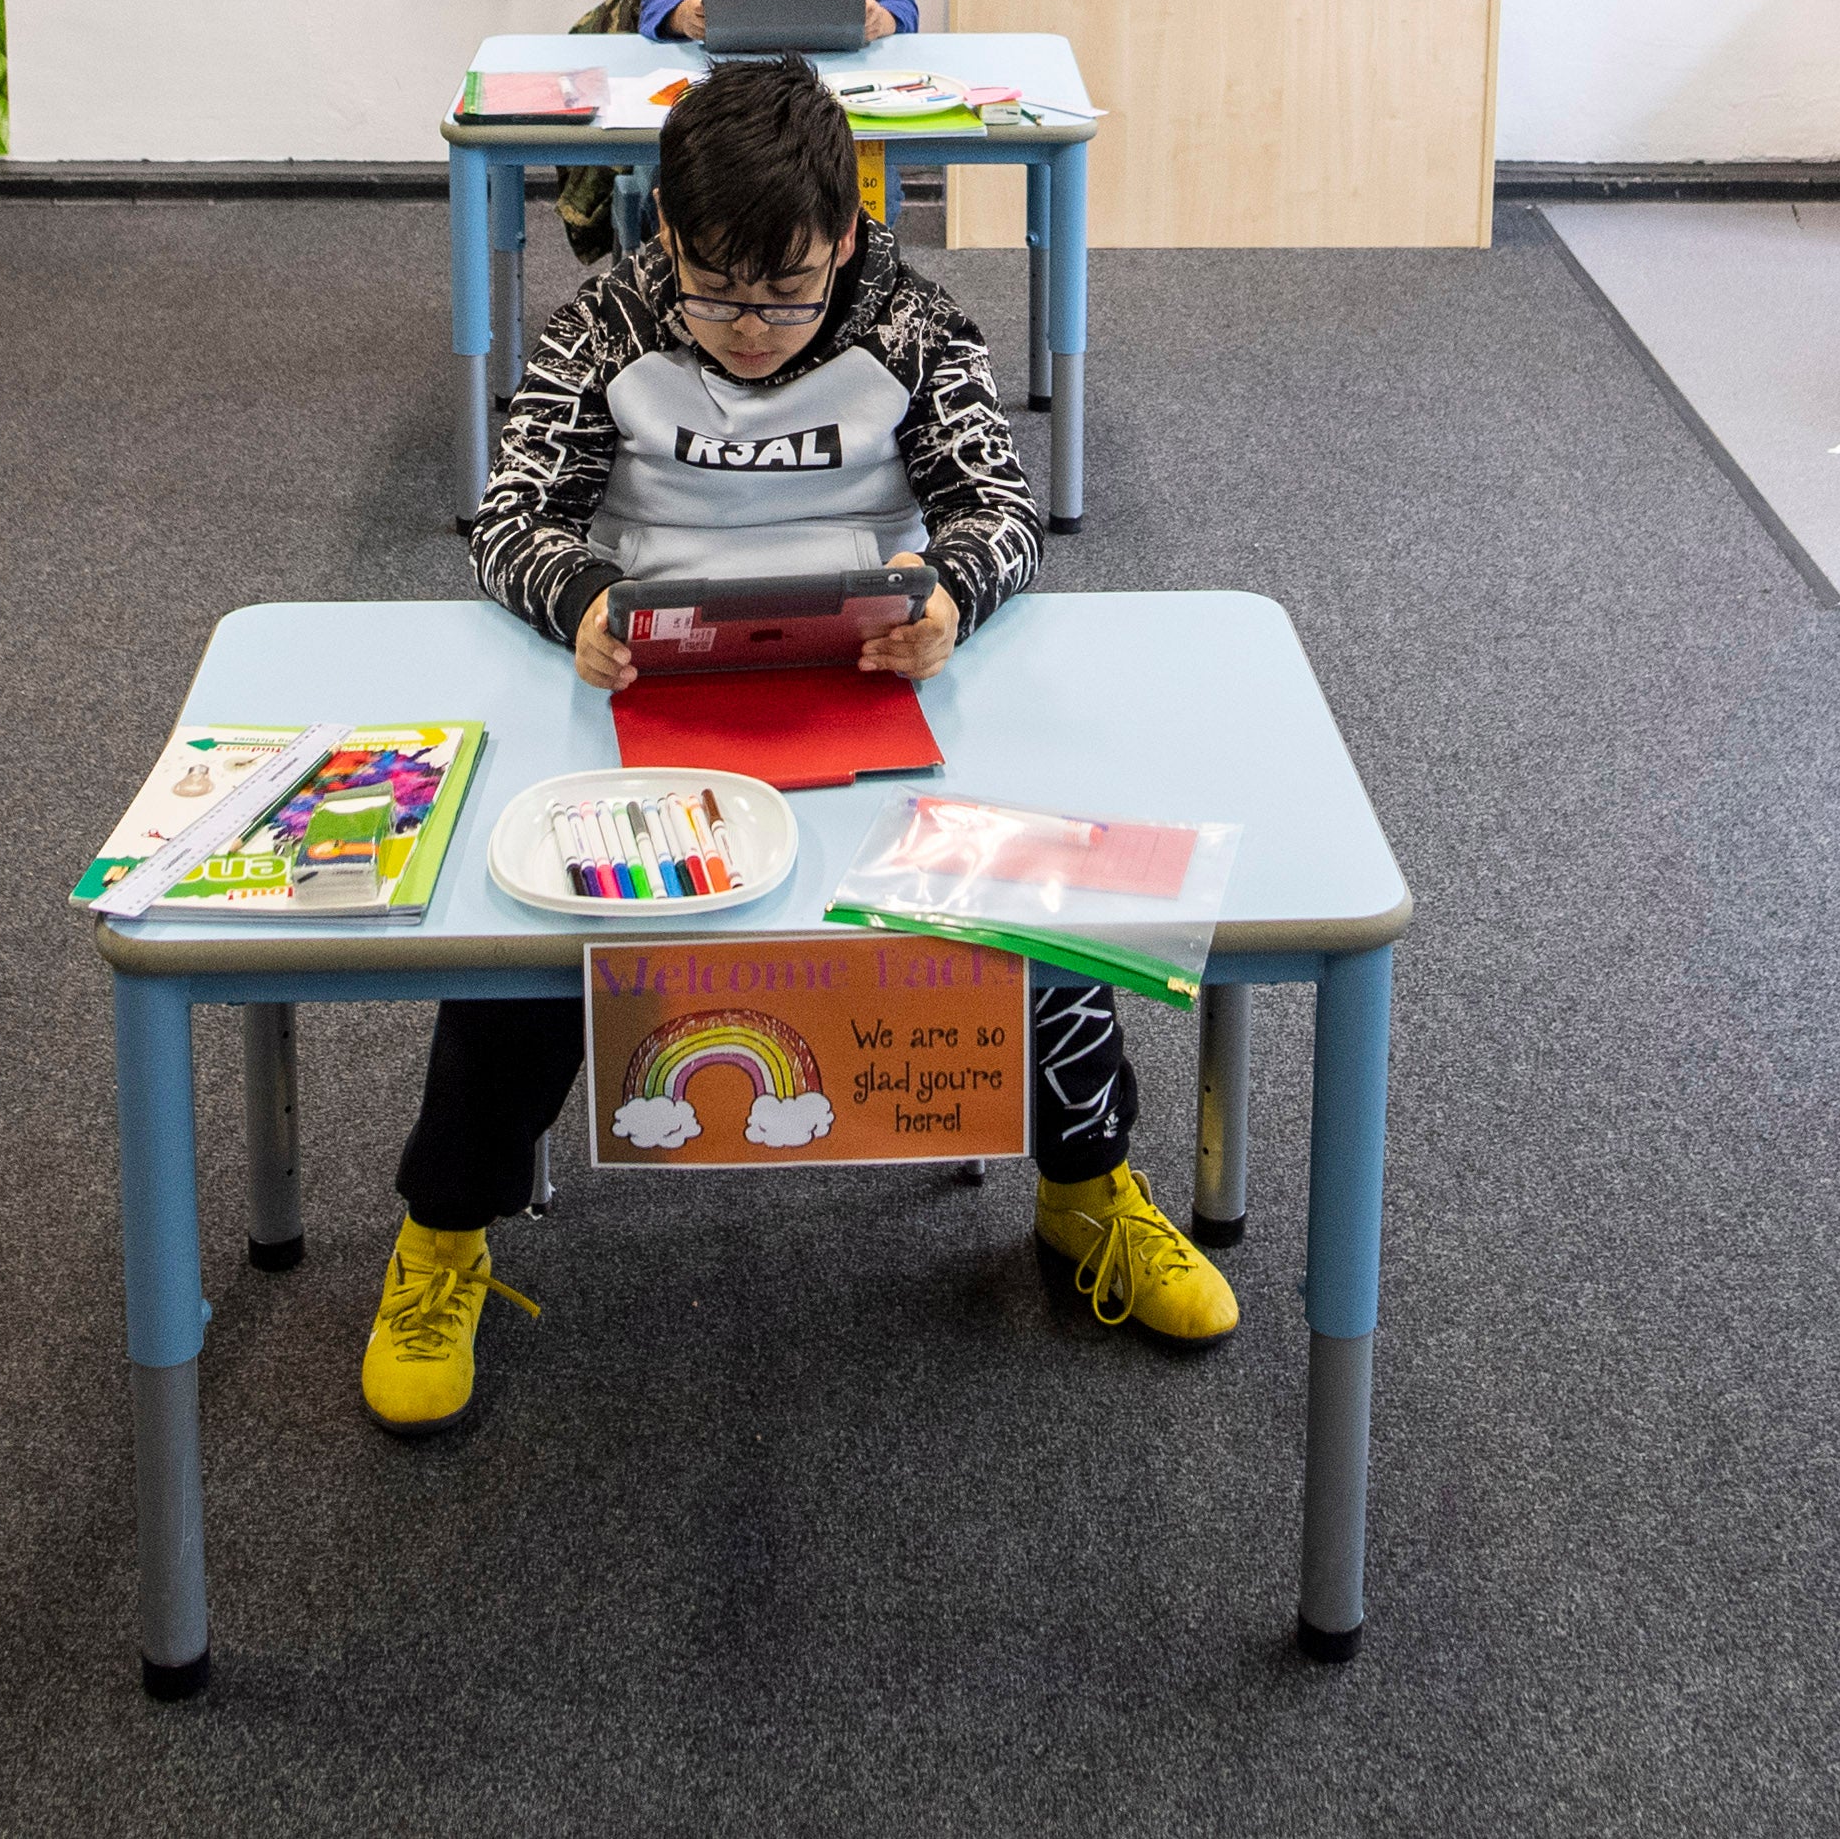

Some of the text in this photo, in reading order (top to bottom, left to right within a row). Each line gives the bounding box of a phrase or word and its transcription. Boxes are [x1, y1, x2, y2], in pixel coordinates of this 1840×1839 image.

[687, 430, 831, 466] R3AL
[594, 957, 848, 998] Welcome
[852, 1019, 1005, 1048] We are so
[854, 1065, 1002, 1103] glad you're
[895, 1104, 961, 1133] here!
